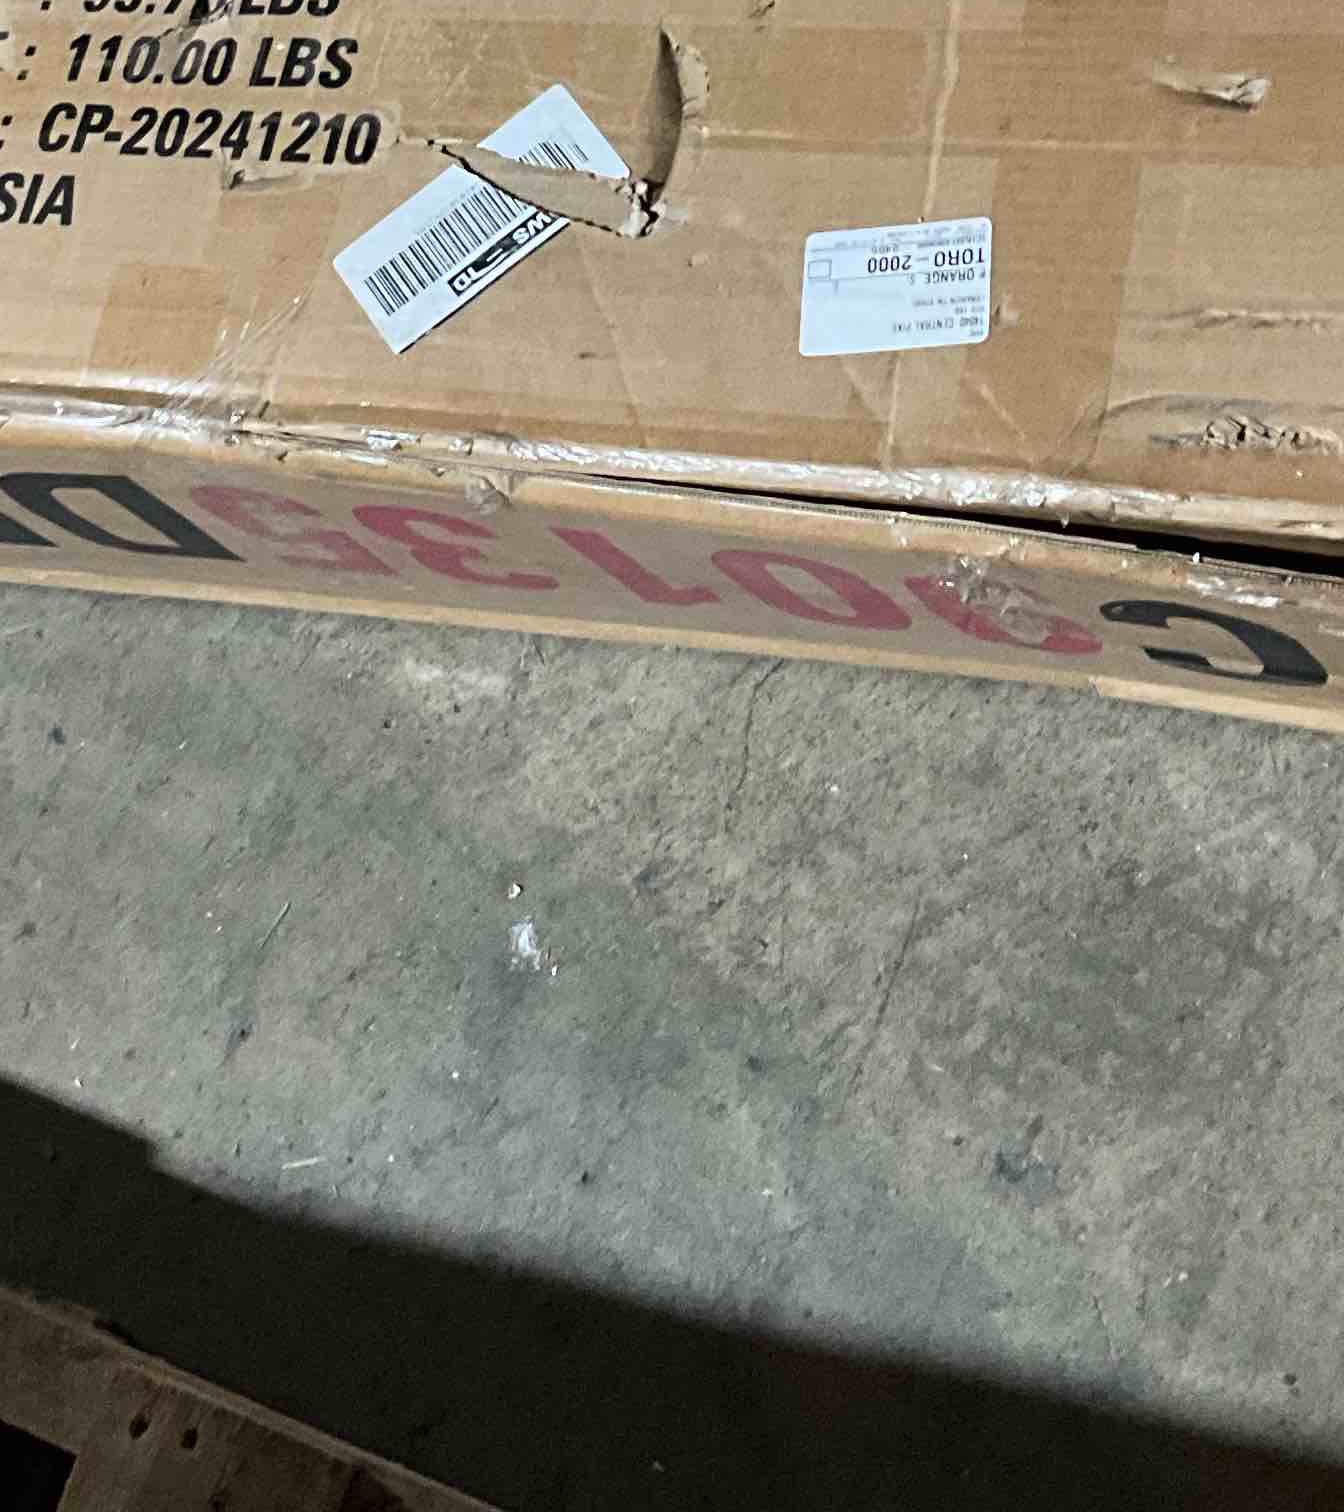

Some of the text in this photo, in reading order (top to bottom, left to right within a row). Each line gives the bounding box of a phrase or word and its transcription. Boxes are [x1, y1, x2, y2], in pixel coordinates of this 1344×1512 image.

[67, 33, 238, 86] 110.00
[249, 36, 359, 89] LBS
[38, 101, 382, 166] CP-20241210
